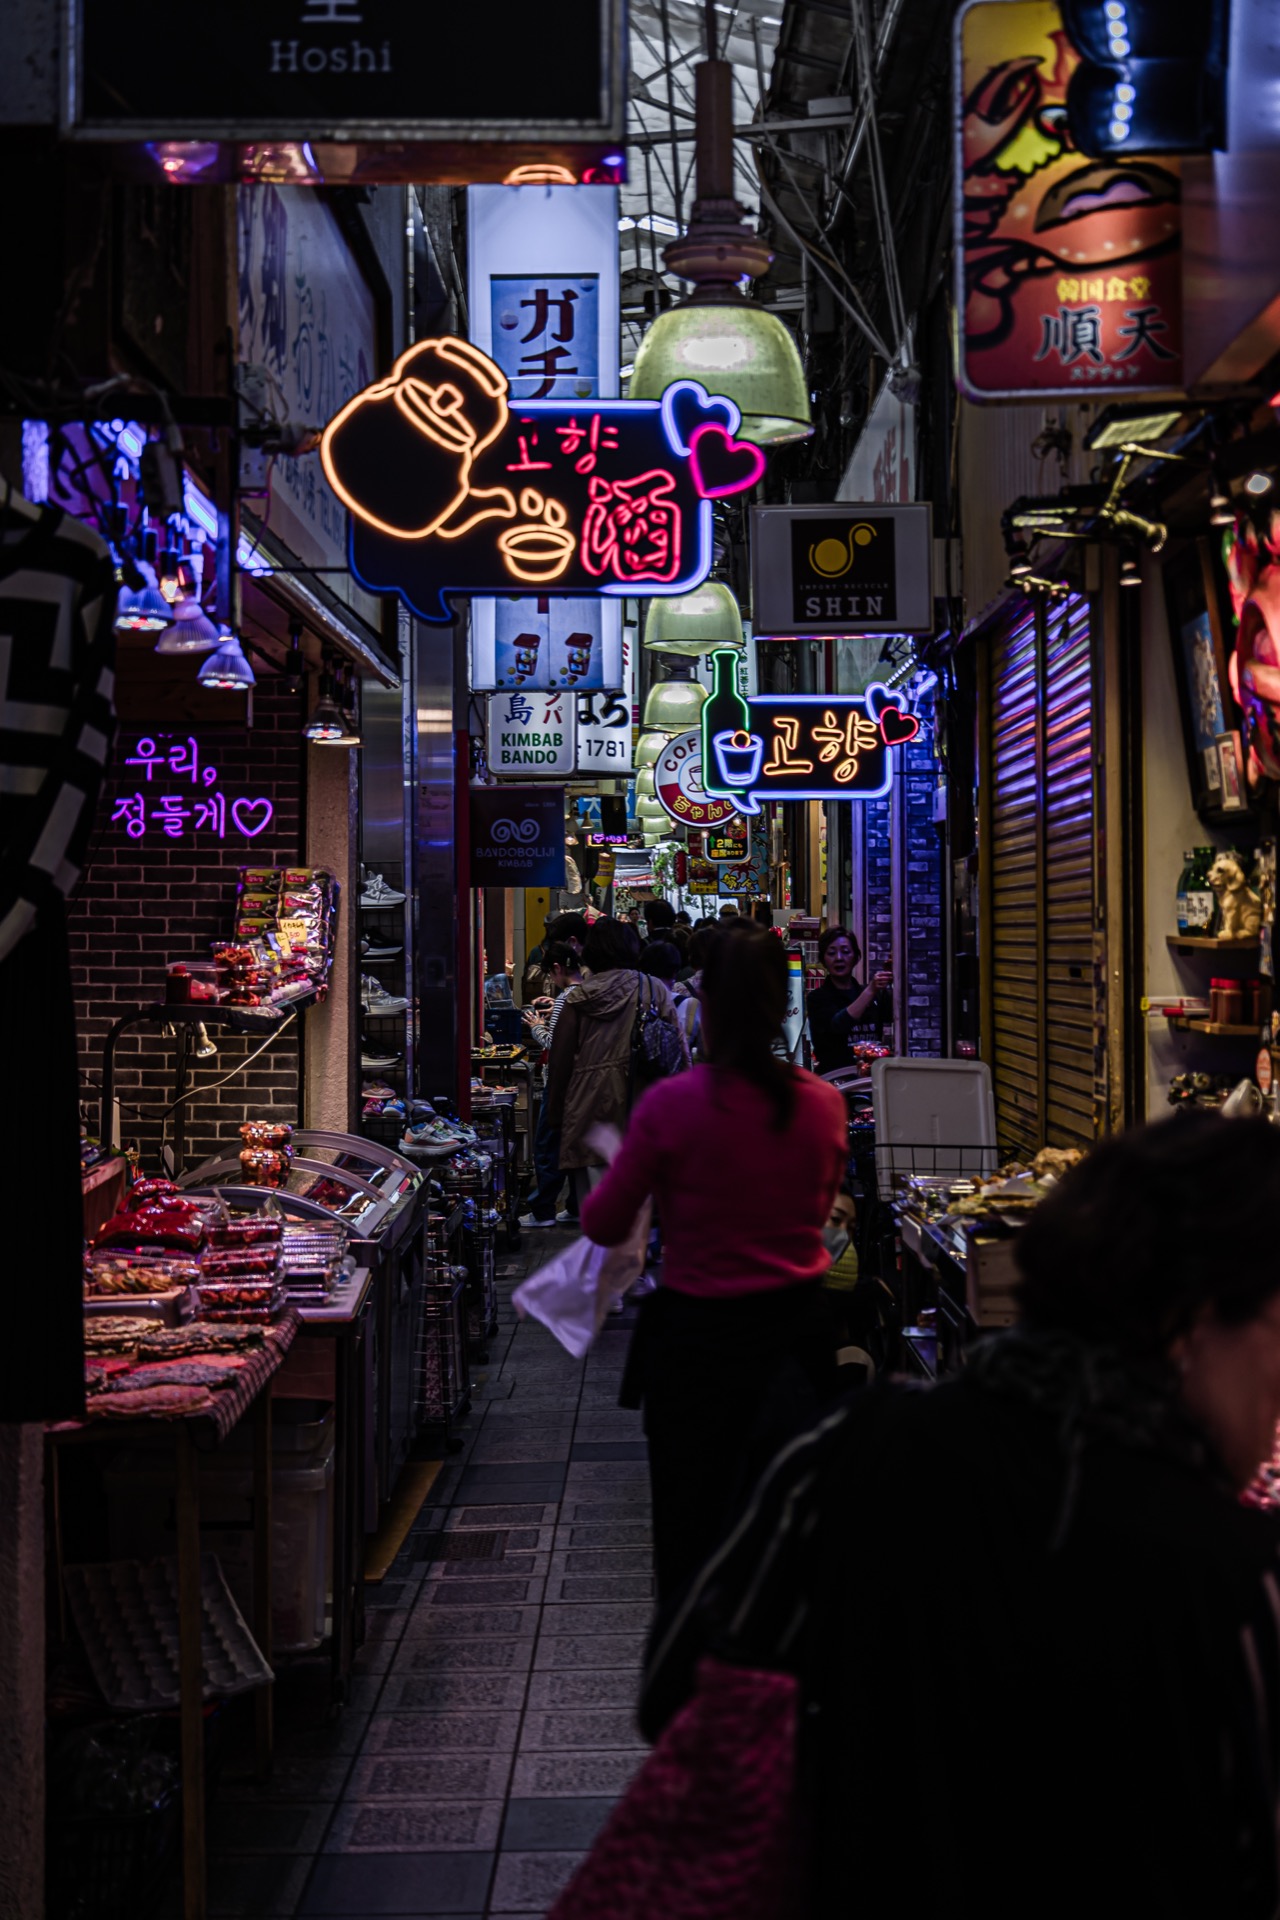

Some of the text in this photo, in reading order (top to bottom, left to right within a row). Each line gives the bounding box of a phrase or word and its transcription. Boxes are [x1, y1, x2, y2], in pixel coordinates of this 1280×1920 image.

[269, 39, 393, 73] Hoshi
[1032, 304, 1180, 366] 順天
[806, 596, 883, 617] SHIN
[502, 733, 563, 746] KIMBAB
[502, 750, 557, 764] BANDO
[763, 710, 878, 783] 고향
[125, 736, 217, 787] 우리,
[111, 792, 225, 839] 정들게
